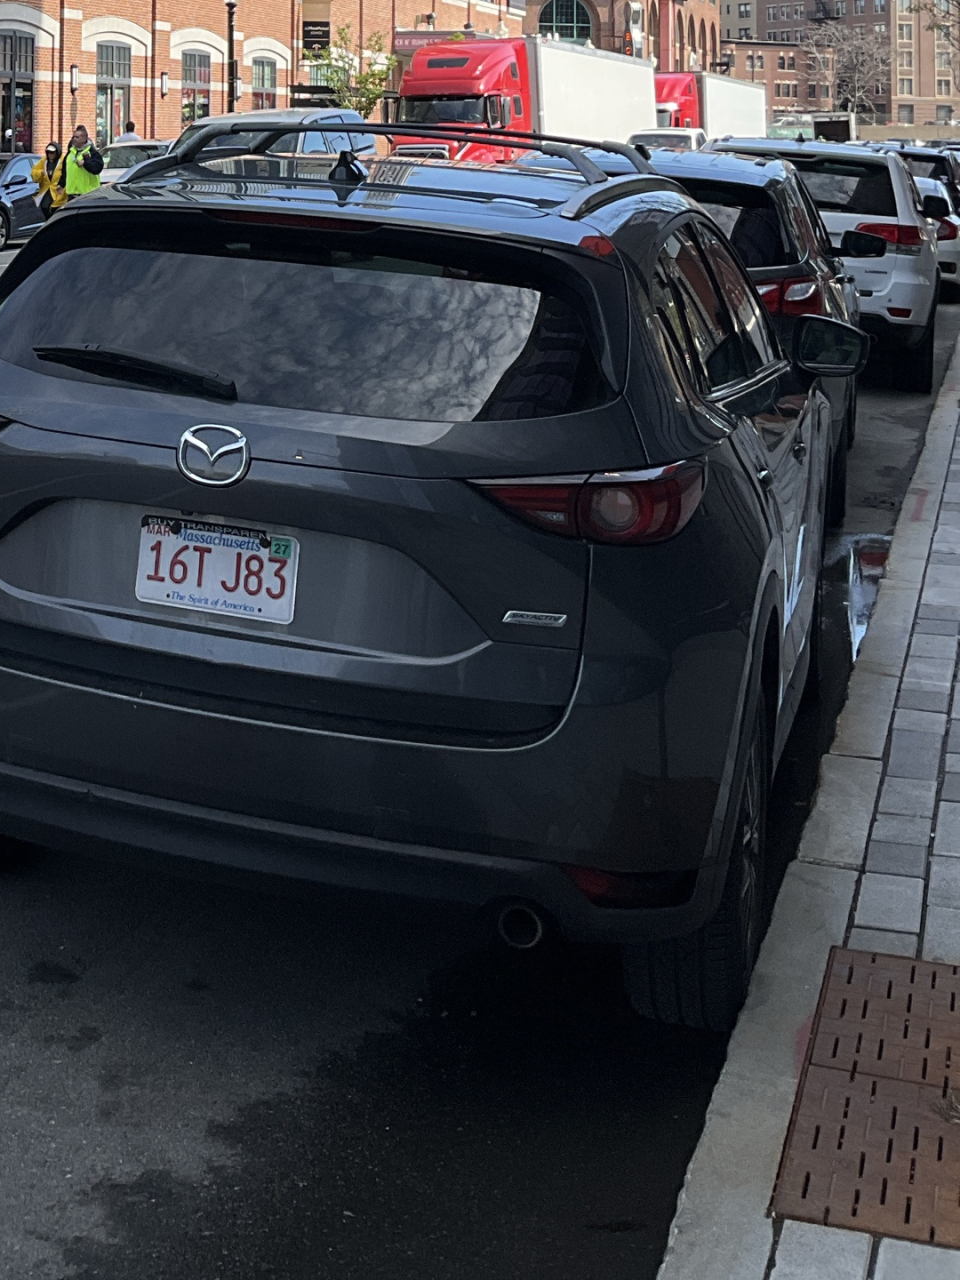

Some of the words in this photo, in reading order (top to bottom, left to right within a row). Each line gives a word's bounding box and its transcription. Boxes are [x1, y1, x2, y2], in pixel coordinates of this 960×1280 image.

[146, 524, 171, 538] MAR
[148, 517, 176, 527] BUY
[176, 528, 262, 552] Massachusetts
[273, 543, 289, 555] 27
[146, 540, 212, 588] 16T
[220, 551, 288, 600] J83
[170, 590, 186, 602] The
[189, 594, 210, 606] Spirit
[210, 599, 219, 607] of
[219, 600, 256, 613] America
